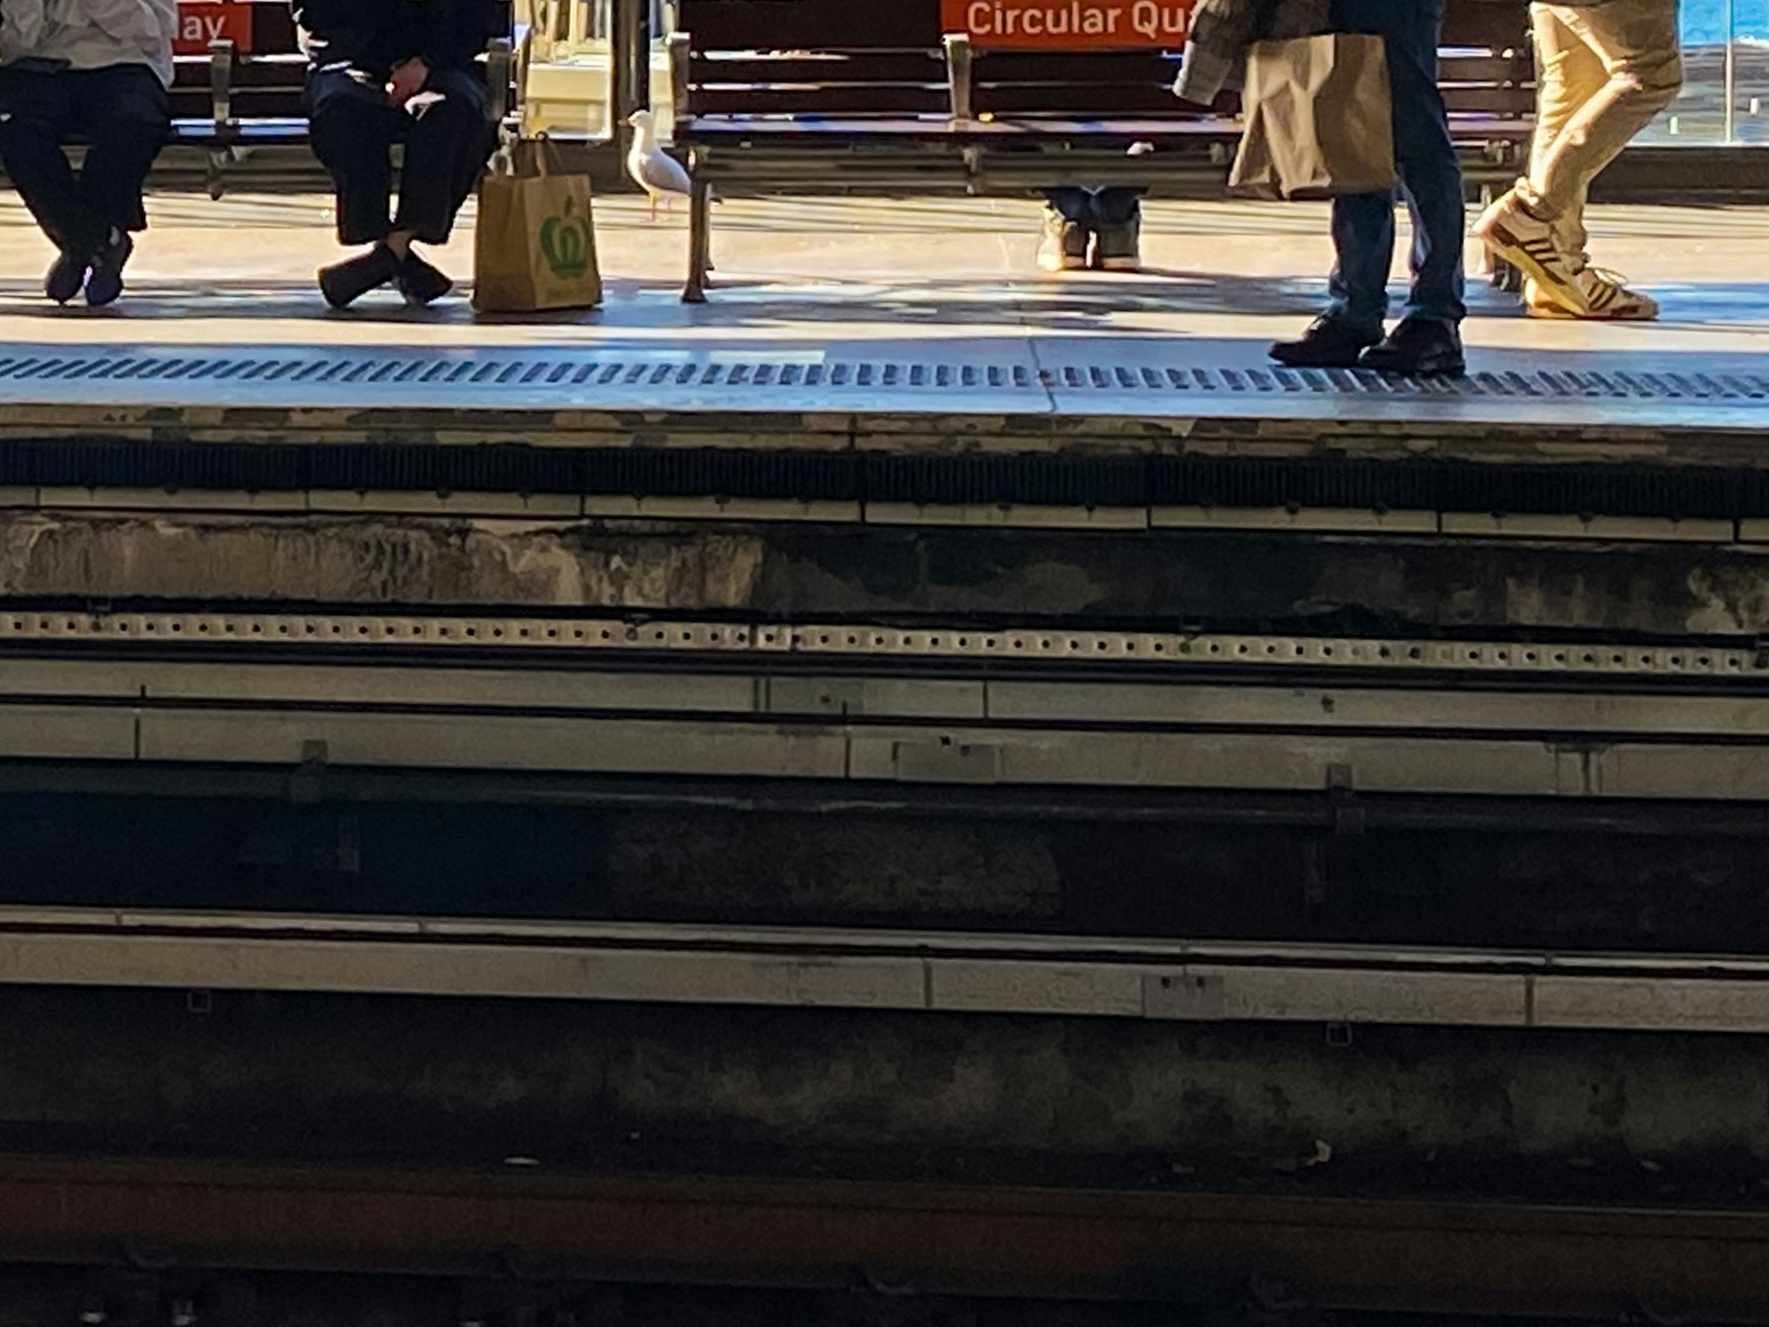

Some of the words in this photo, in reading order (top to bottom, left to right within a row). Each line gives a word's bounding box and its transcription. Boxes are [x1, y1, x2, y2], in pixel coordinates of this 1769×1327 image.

[176, 14, 227, 41] ay
[967, 0, 1122, 34] Circular
[1132, 0, 1193, 40] Qu
